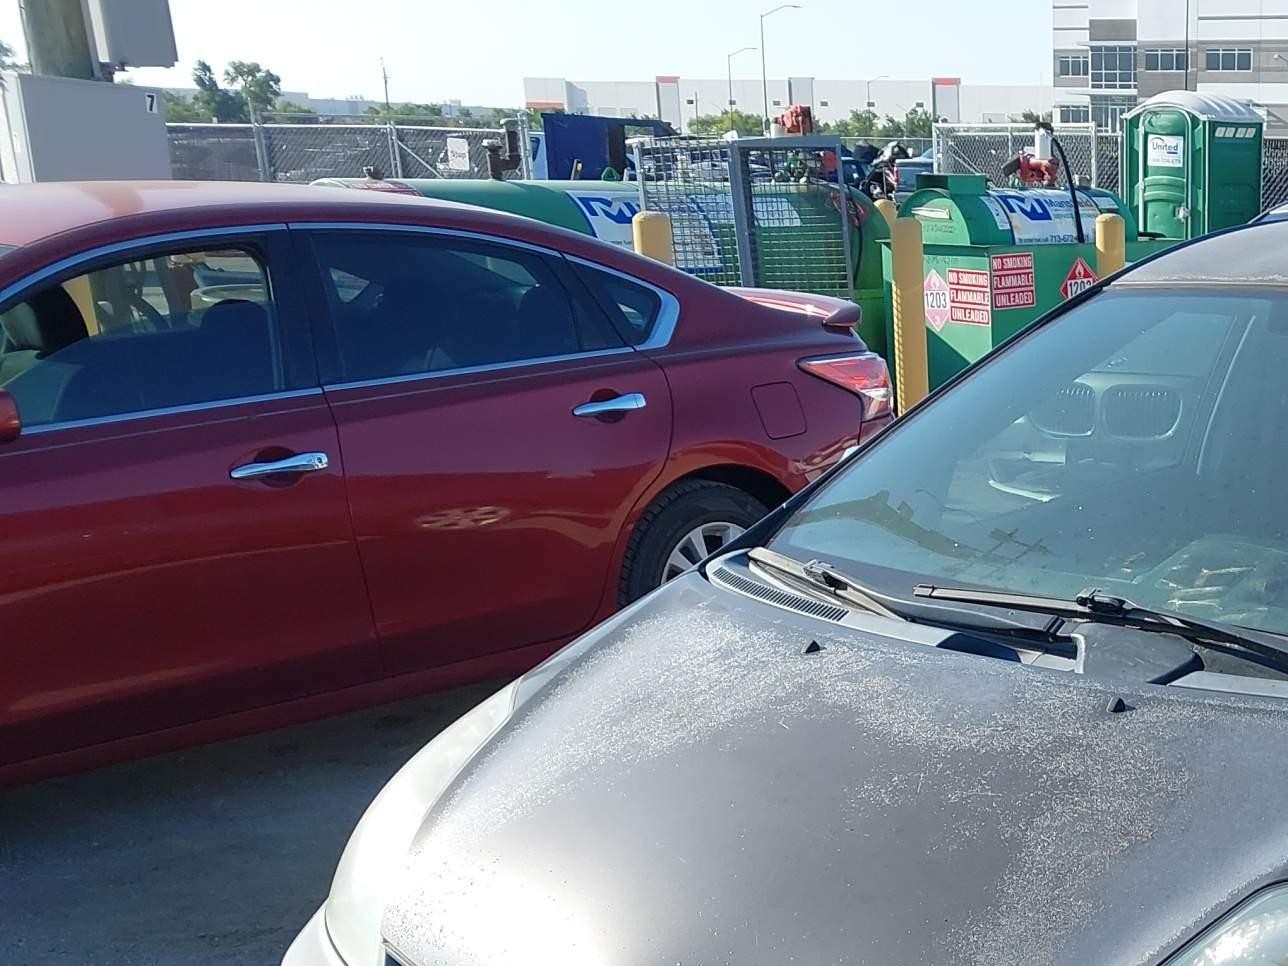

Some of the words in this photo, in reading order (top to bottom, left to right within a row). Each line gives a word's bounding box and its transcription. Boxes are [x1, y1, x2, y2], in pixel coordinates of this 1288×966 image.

[146, 94, 155, 112] 7
[1152, 141, 1179, 151] United
[1046, 199, 1093, 208] Manseld
[1050, 234, 1089, 243] 713-672-1
[992, 258, 1001, 269] NO
[1002, 256, 1032, 268] SMOKING
[949, 273, 958, 284] NO
[959, 274, 989, 286] SMOKING
[993, 273, 1033, 288] FLAMMABLE
[925, 291, 947, 309] 1203
[950, 290, 990, 304] FLAMMABLE
[995, 291, 1034, 307] UNLEADED
[951, 308, 989, 323] UNLEADED
